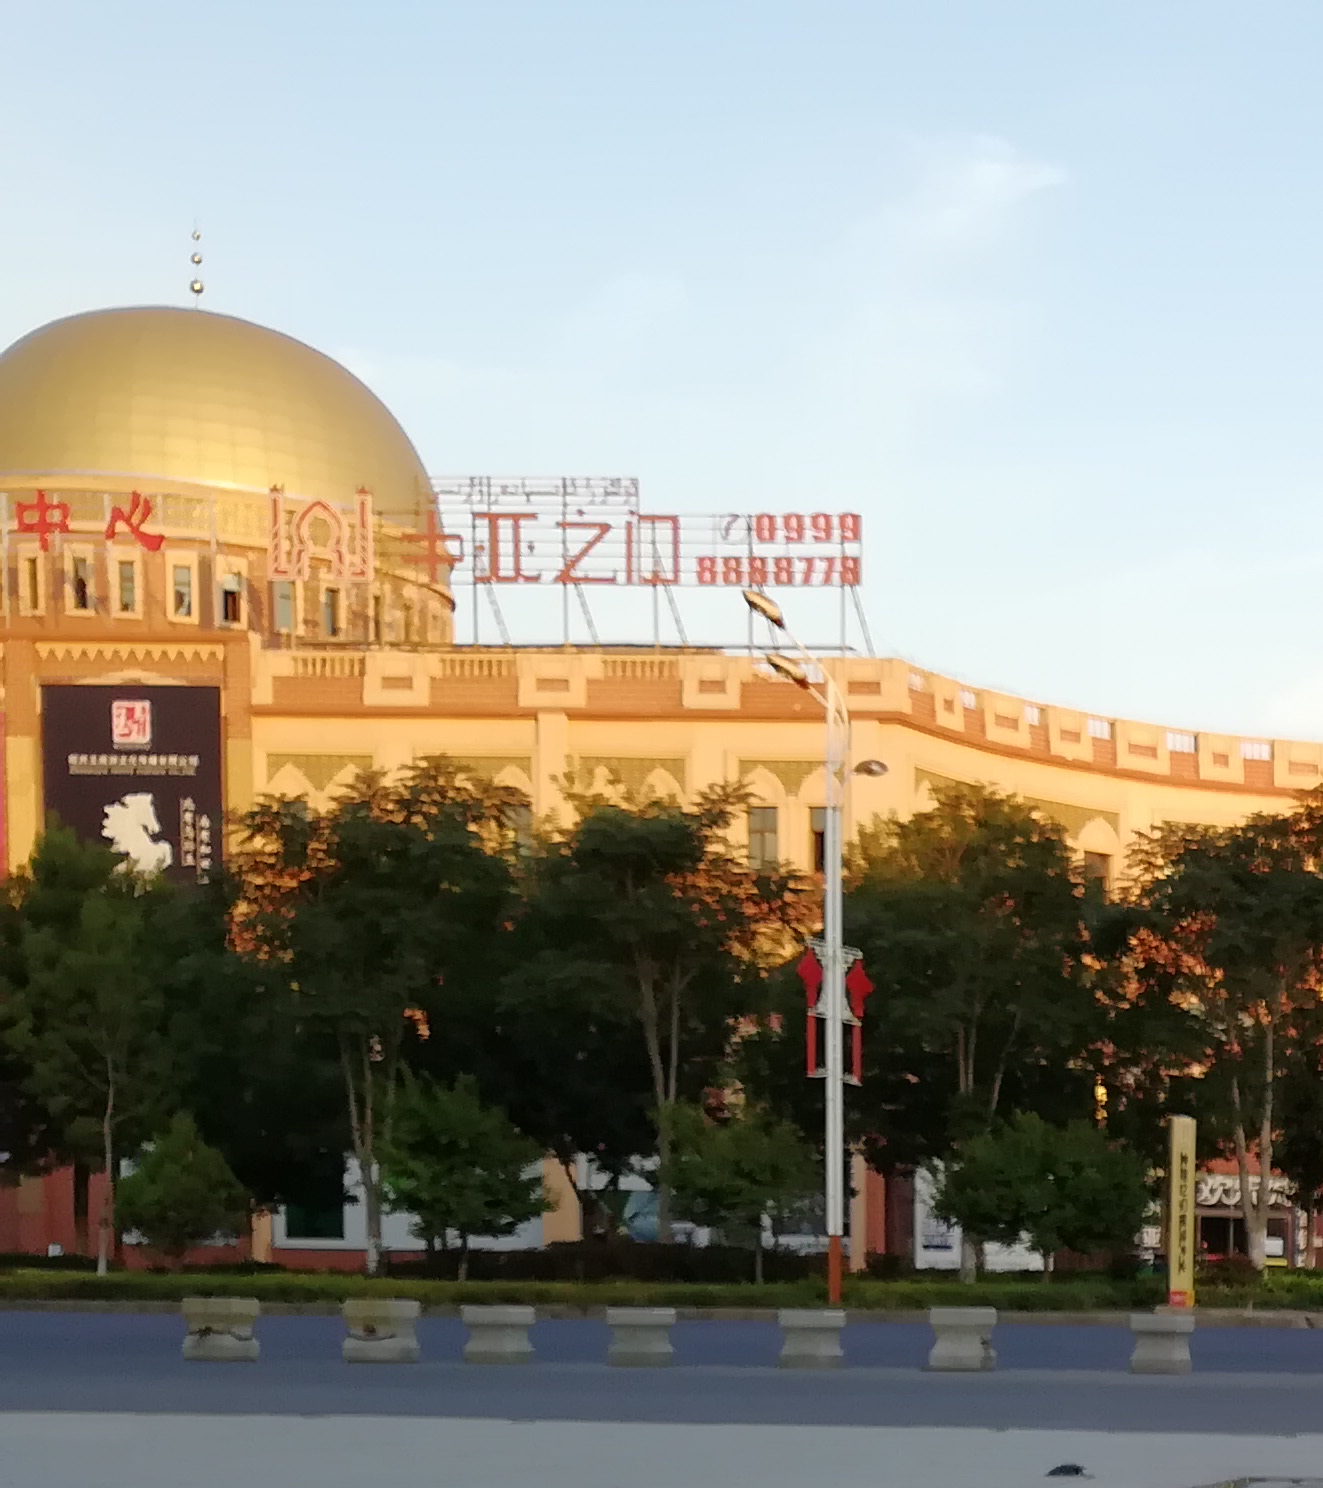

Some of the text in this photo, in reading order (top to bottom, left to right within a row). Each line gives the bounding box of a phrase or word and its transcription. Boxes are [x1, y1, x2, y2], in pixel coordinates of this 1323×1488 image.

[15, 489, 165, 551] 中心
[399, 509, 681, 585] 中亚之门
